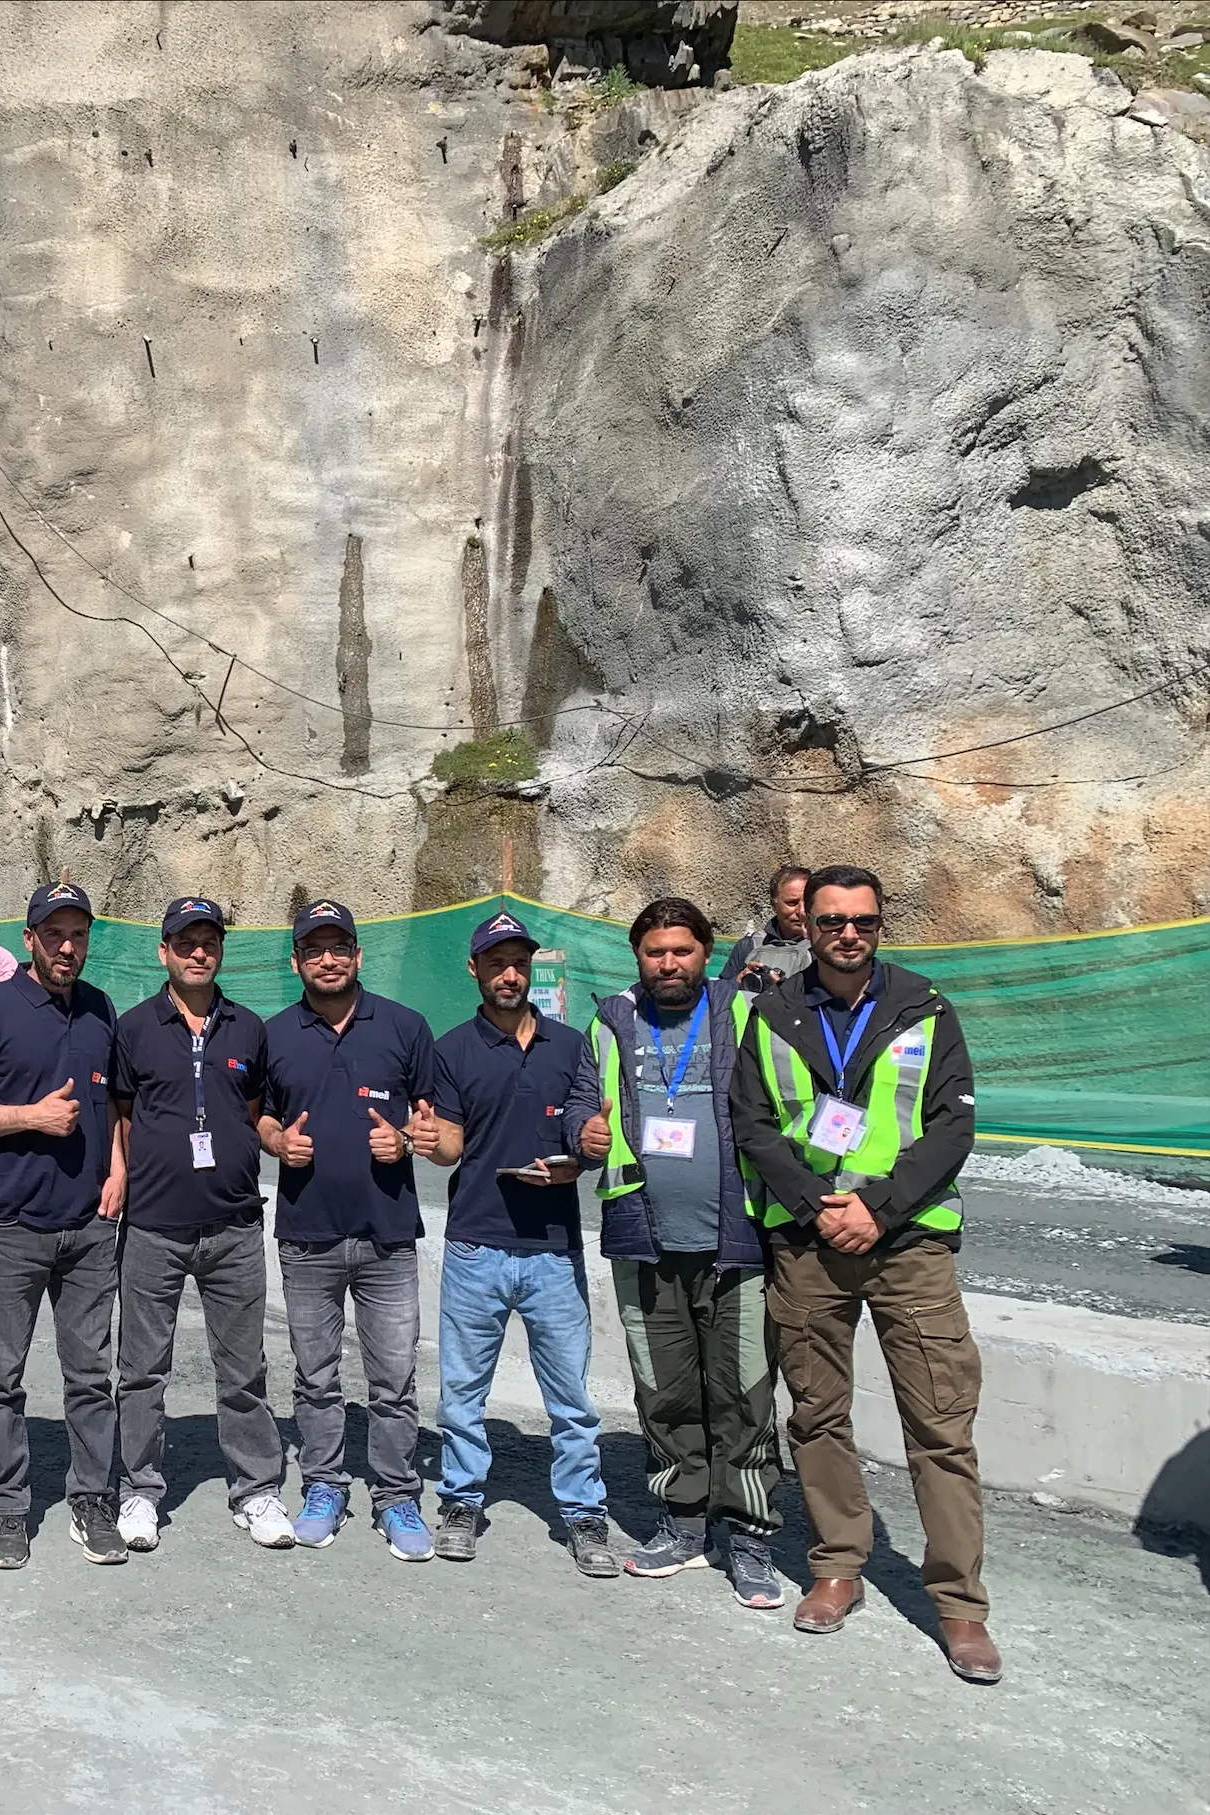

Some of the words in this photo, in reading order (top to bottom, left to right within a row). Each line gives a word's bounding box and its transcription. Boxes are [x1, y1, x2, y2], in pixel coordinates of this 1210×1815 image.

[535, 968, 556, 982] THINK
[904, 1044, 926, 1056] meil
[369, 1089, 390, 1101] meil
